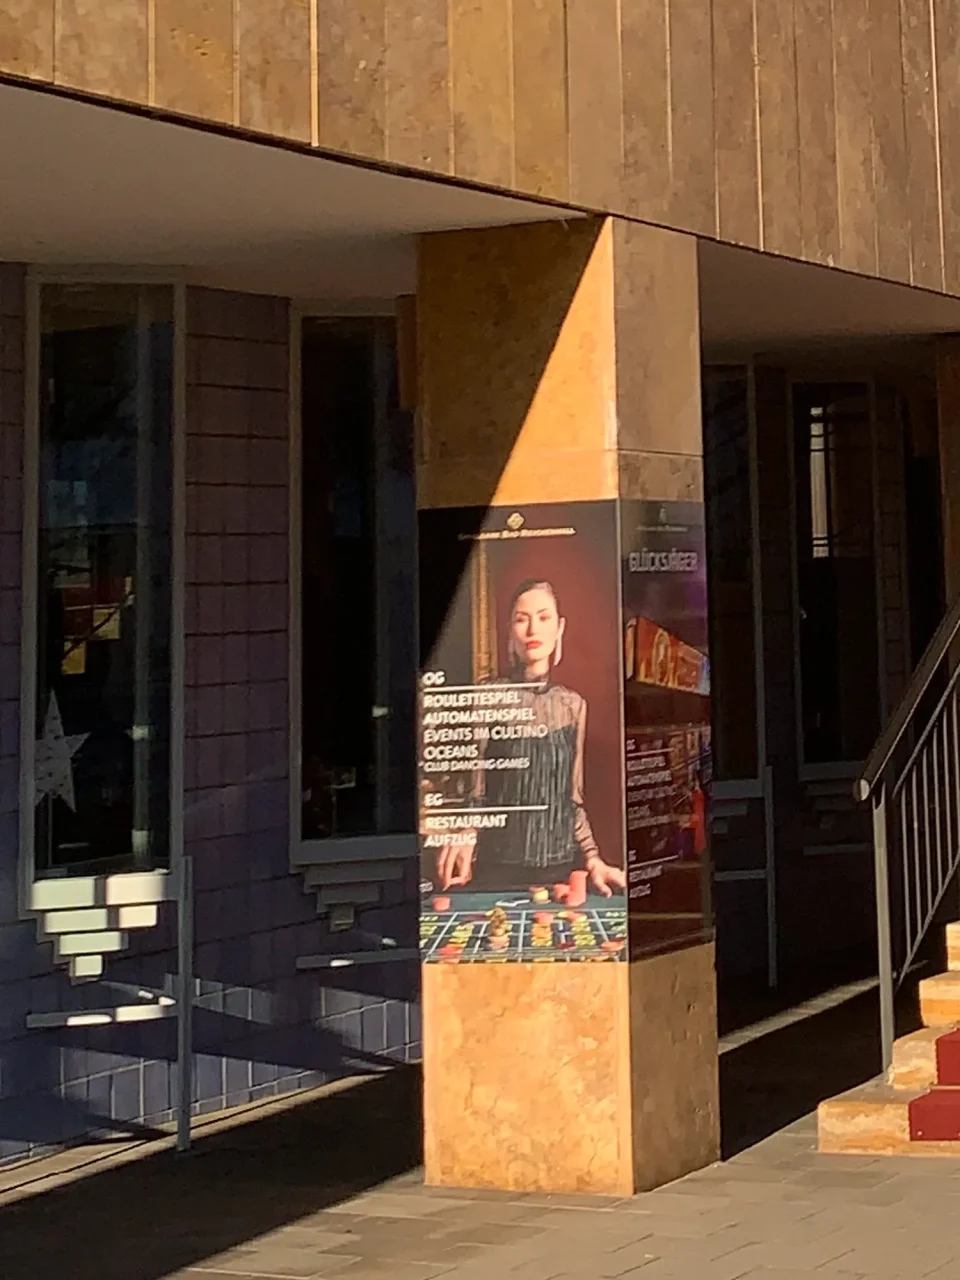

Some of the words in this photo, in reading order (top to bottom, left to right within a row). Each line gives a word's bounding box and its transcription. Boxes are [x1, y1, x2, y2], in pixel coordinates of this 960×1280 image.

[422, 671, 446, 686] OG
[423, 691, 521, 708] ROULETTESPIEL
[422, 707, 537, 726] AUTOMATENSPIEL
[423, 727, 473, 744] EVENTS
[423, 744, 478, 760] OCEANS
[424, 793, 444, 807] EG
[425, 814, 508, 830] RESTAURANT
[423, 832, 478, 848] AUFZUG
